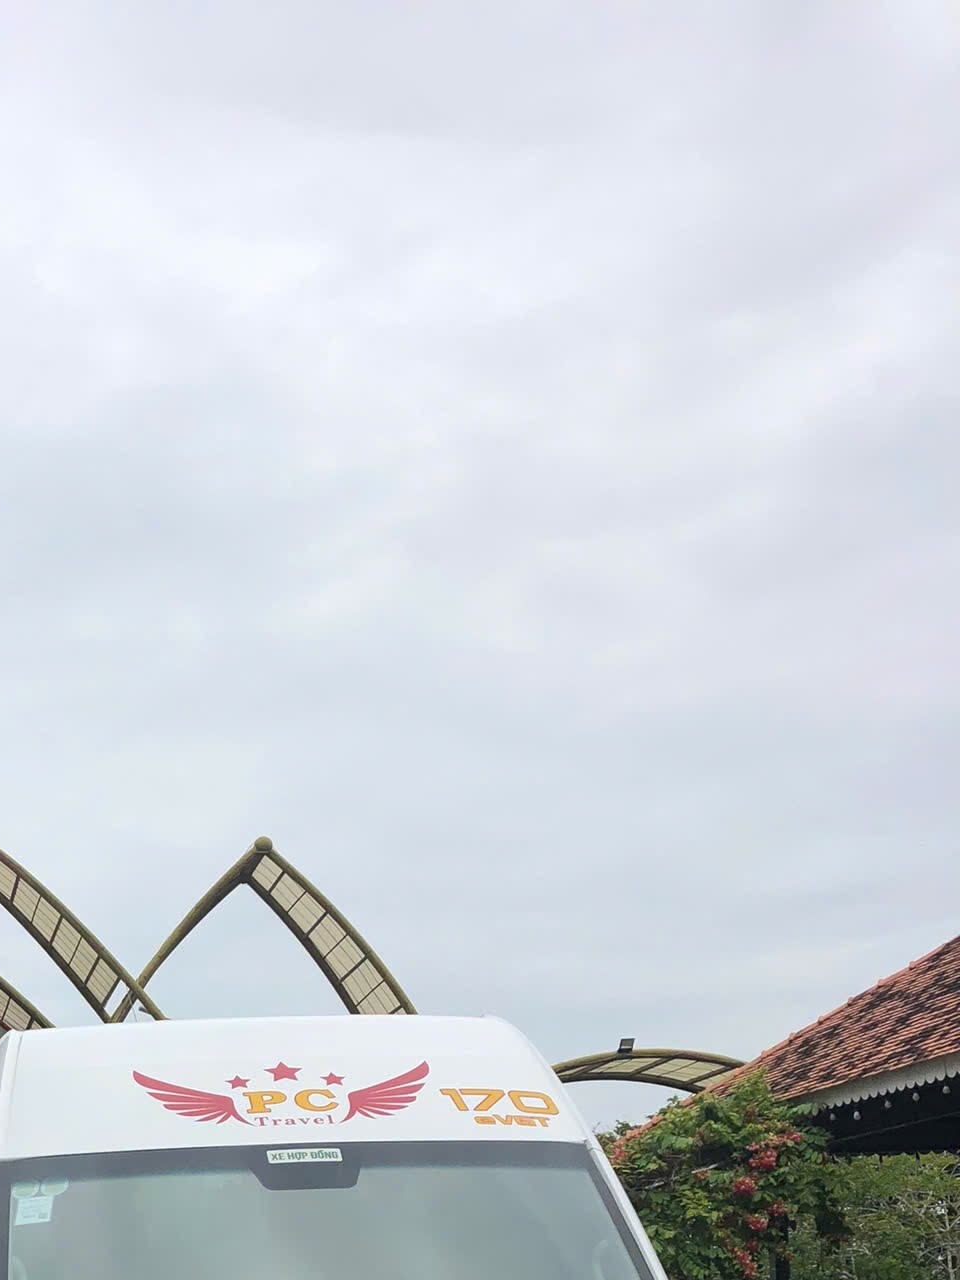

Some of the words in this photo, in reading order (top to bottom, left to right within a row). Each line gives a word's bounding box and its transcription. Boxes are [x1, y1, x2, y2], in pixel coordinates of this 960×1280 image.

[242, 1089, 339, 1114] PC
[440, 1088, 559, 1115] 170
[254, 1115, 334, 1127] Travel
[271, 1152, 286, 1161] XE
